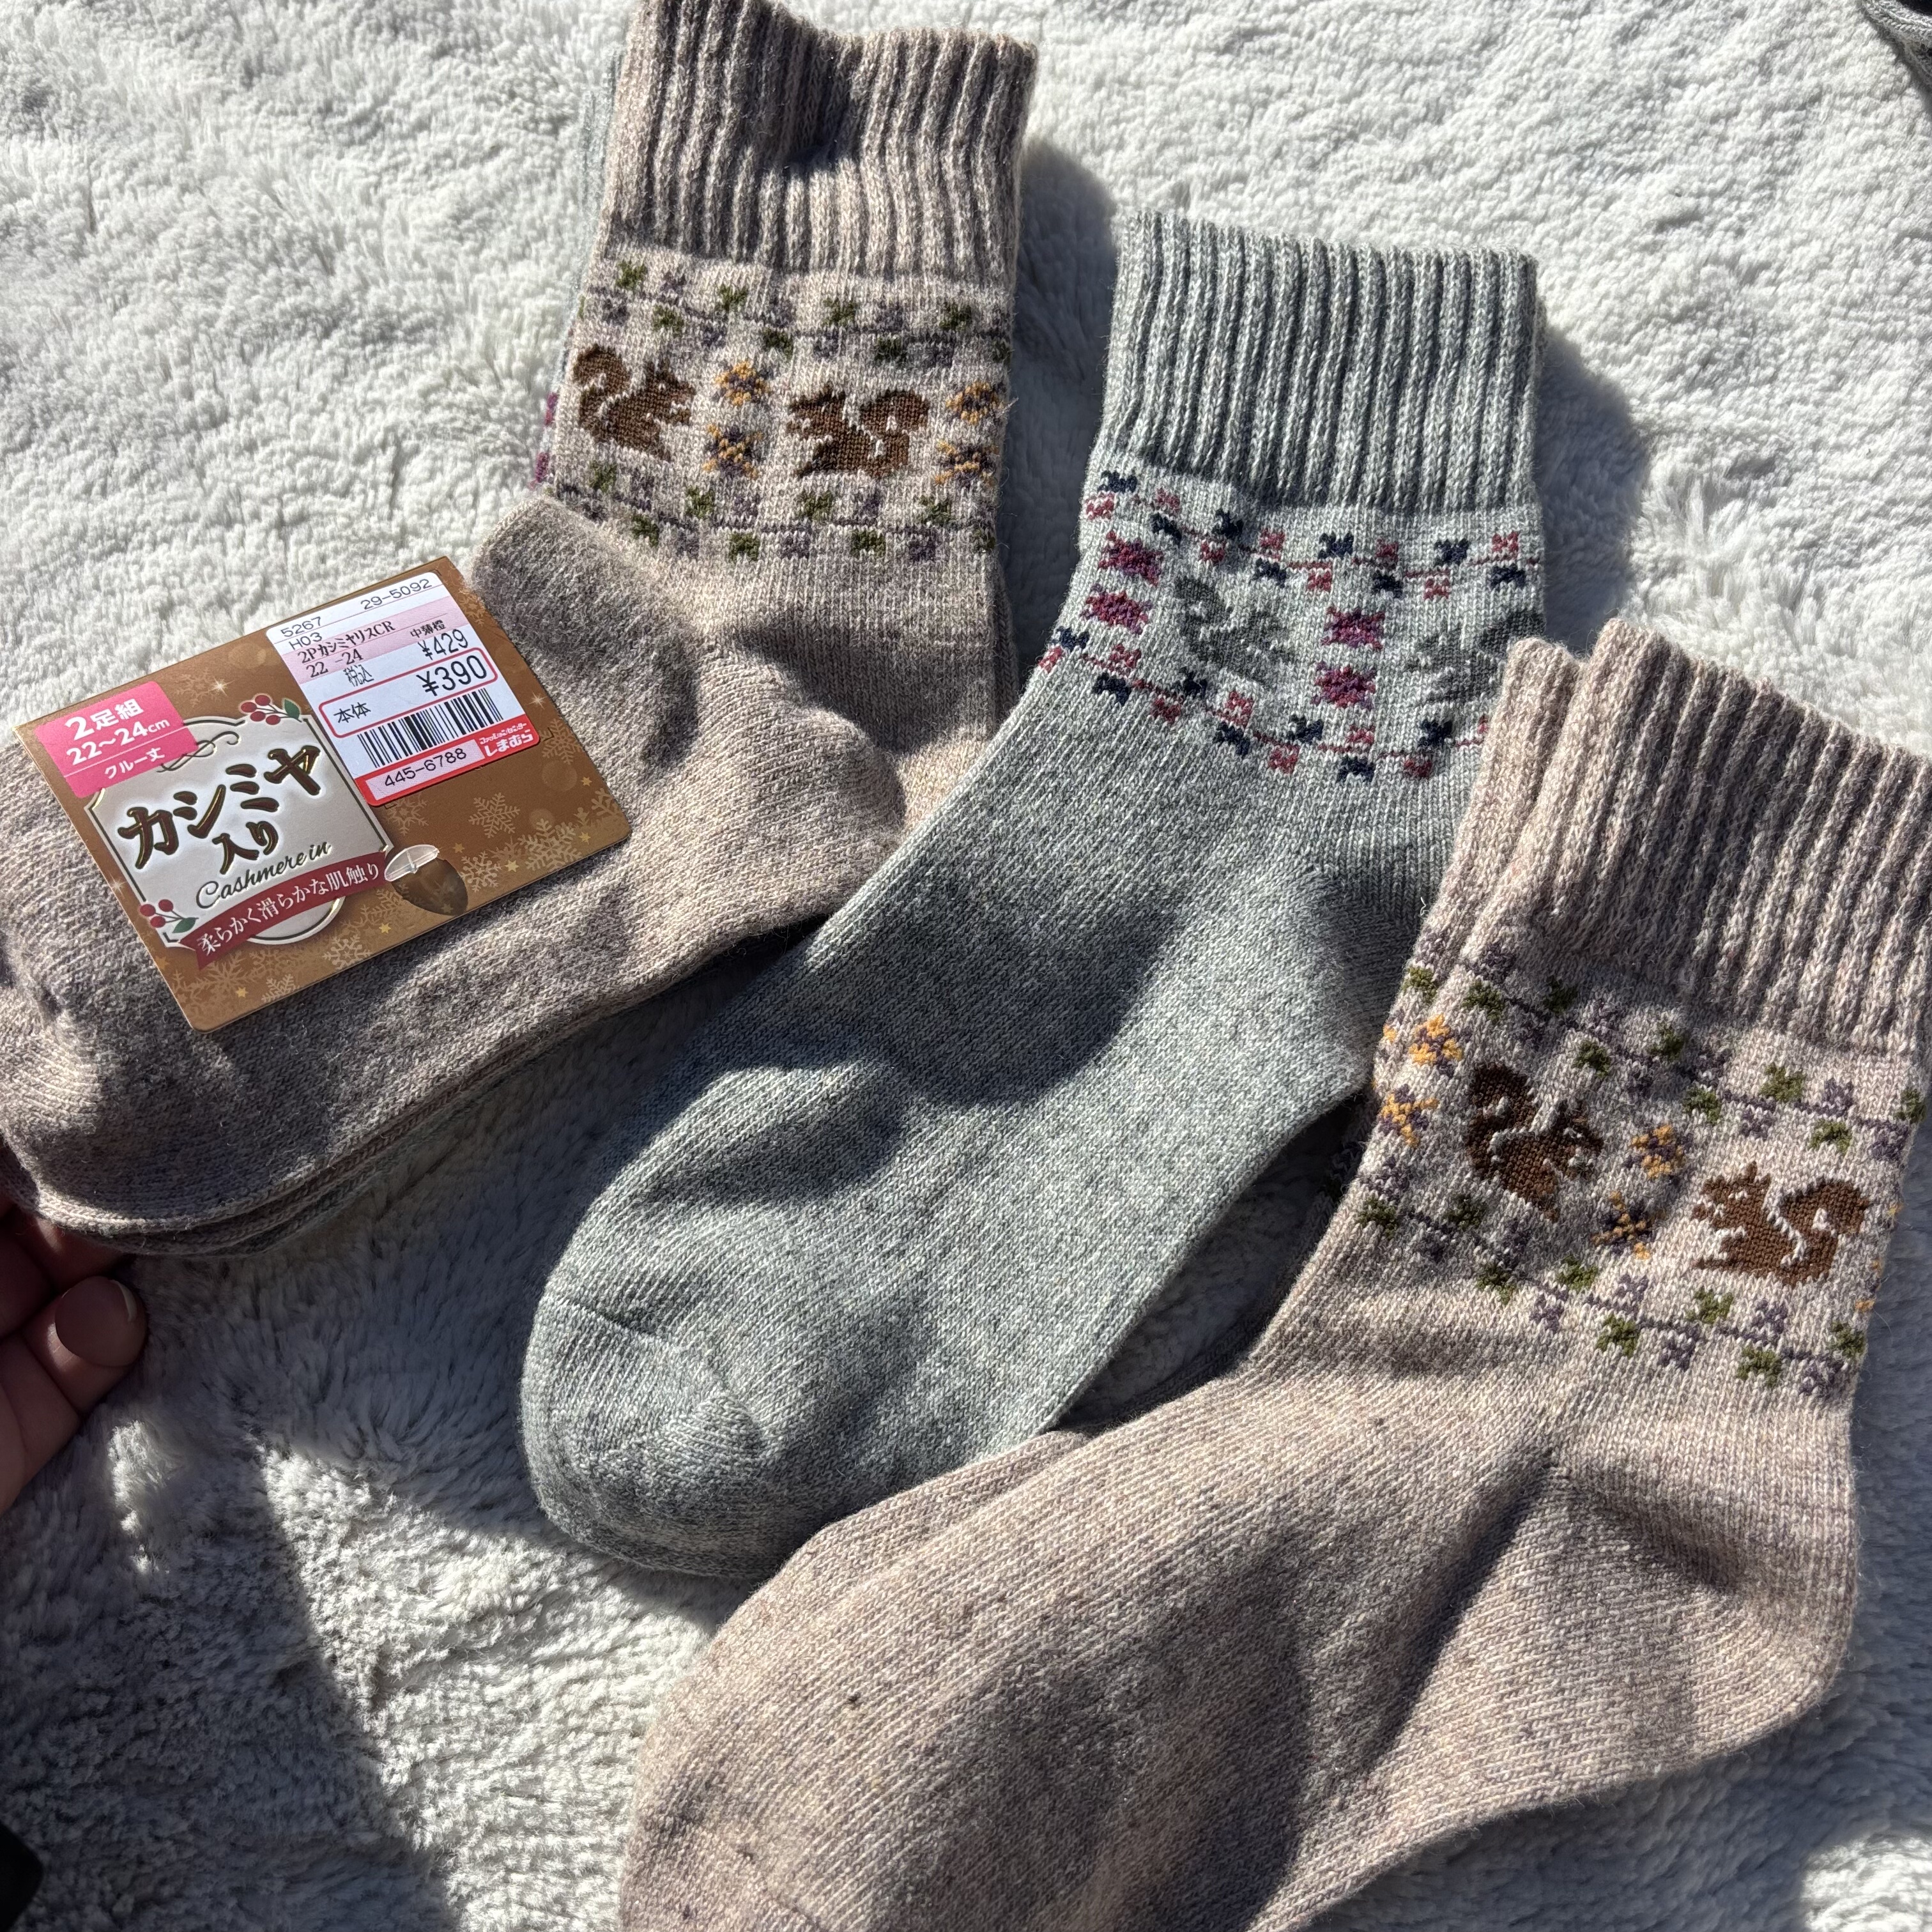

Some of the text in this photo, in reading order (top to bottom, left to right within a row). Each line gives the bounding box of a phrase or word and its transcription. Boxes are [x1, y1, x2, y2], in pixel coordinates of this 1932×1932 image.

[360, 578, 432, 610] 29-5092
[280, 616, 321, 638] 5267
[289, 631, 323, 650] H03
[297, 620, 395, 663] 2PカシミヤリスCR
[417, 629, 468, 661] ¥429
[343, 664, 374, 687] 税込
[416, 655, 487, 696] ¥390
[65, 698, 144, 740] 2足組
[334, 702, 371, 723] 本体
[484, 729, 533, 757] しまむら
[104, 747, 165, 779] クルー丈
[385, 748, 466, 786] 445-6788
[118, 745, 321, 870] カシミヤ
[212, 820, 279, 875] 入り
[196, 841, 332, 908] Cashmere in
[197, 862, 379, 956] 柔らかく滑らかな肌触り
